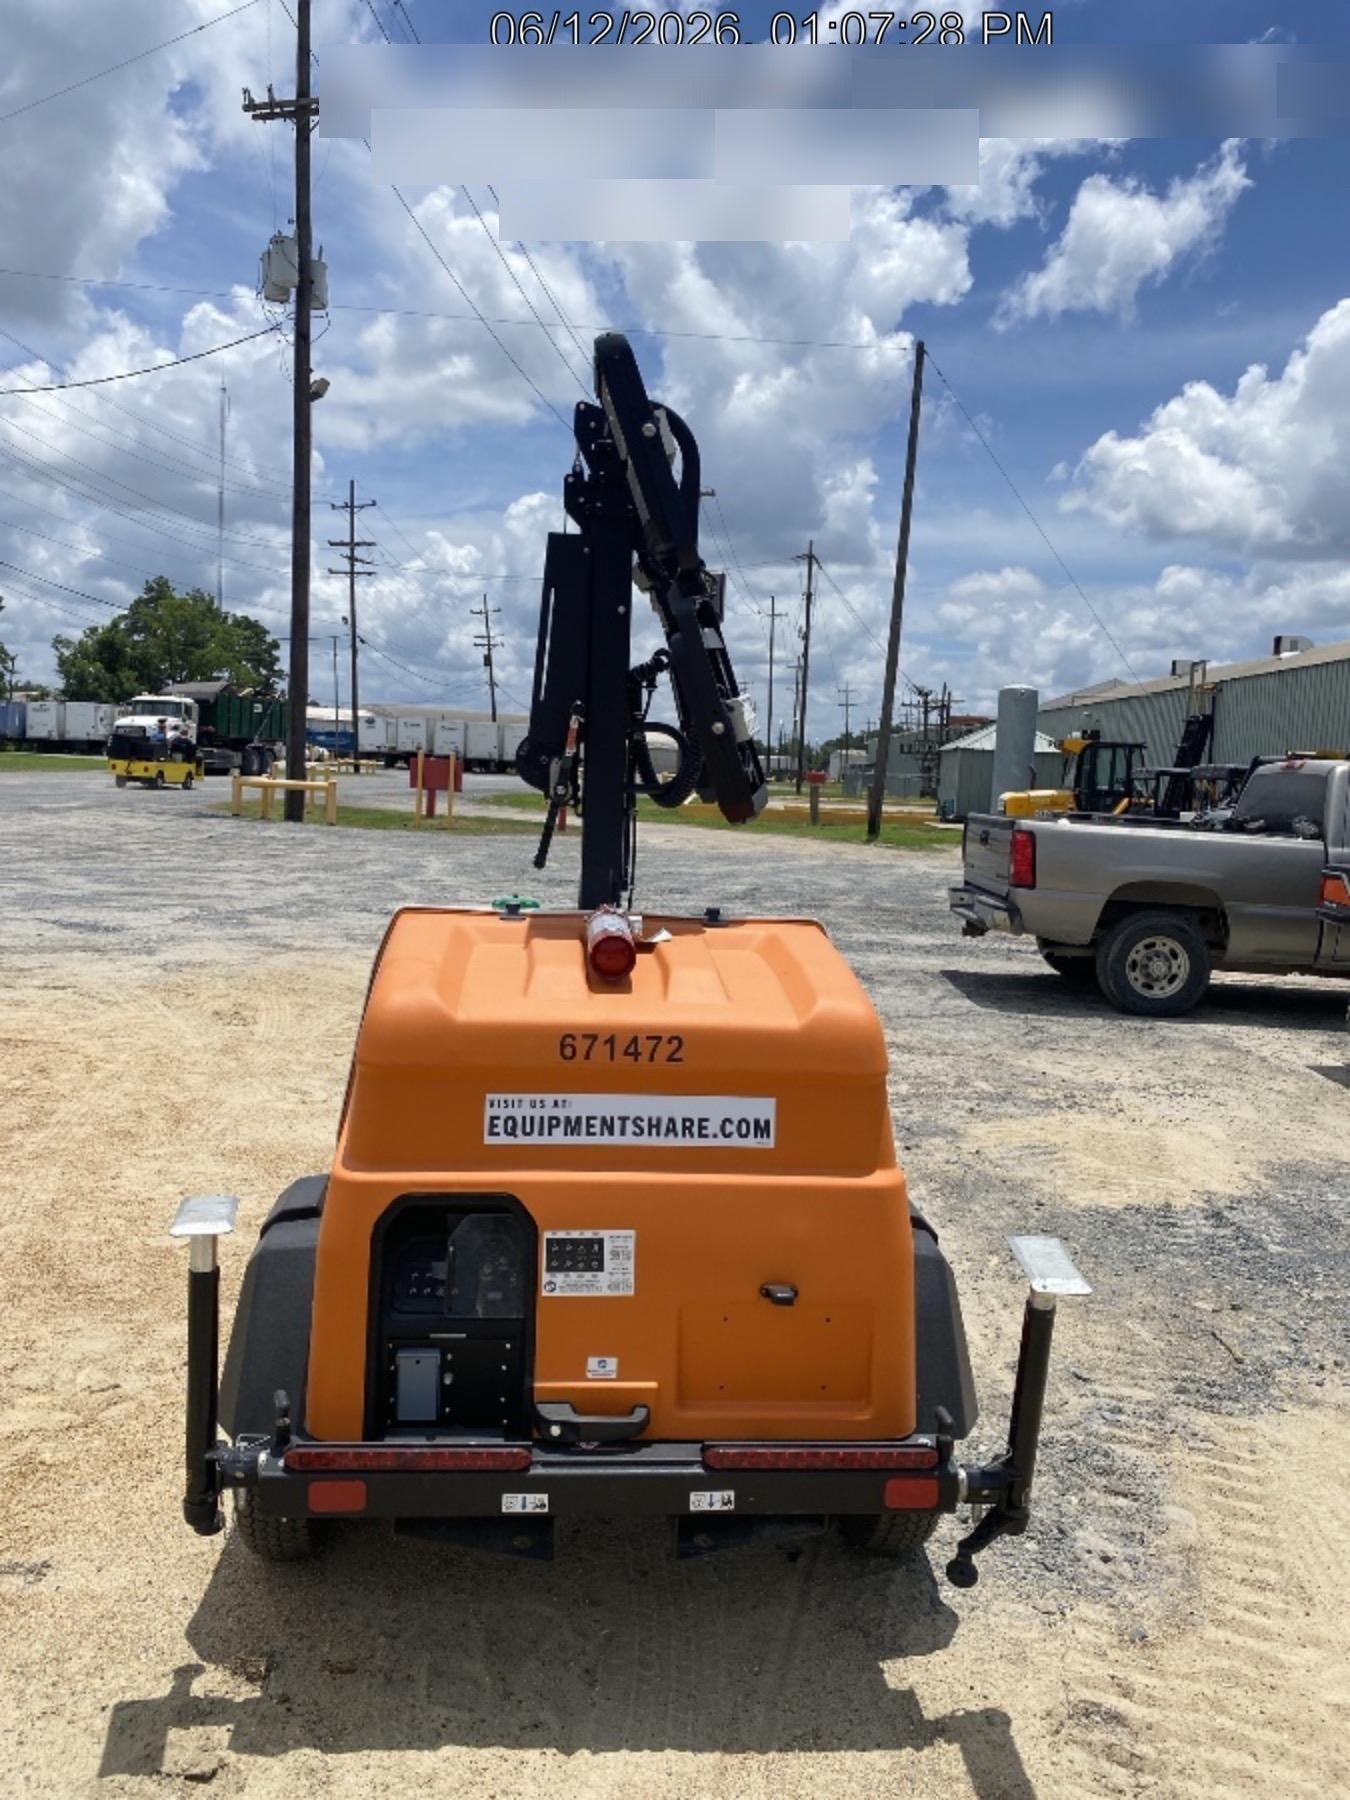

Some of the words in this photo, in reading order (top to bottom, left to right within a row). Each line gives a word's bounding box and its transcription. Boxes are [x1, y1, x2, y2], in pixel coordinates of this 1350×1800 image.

[559, 1034, 684, 1062] 671472
[489, 1099, 523, 1108] VISIT
[530, 1099, 545, 1109] US
[487, 1115, 771, 1139] EQUIPMENTSHARE.COM
